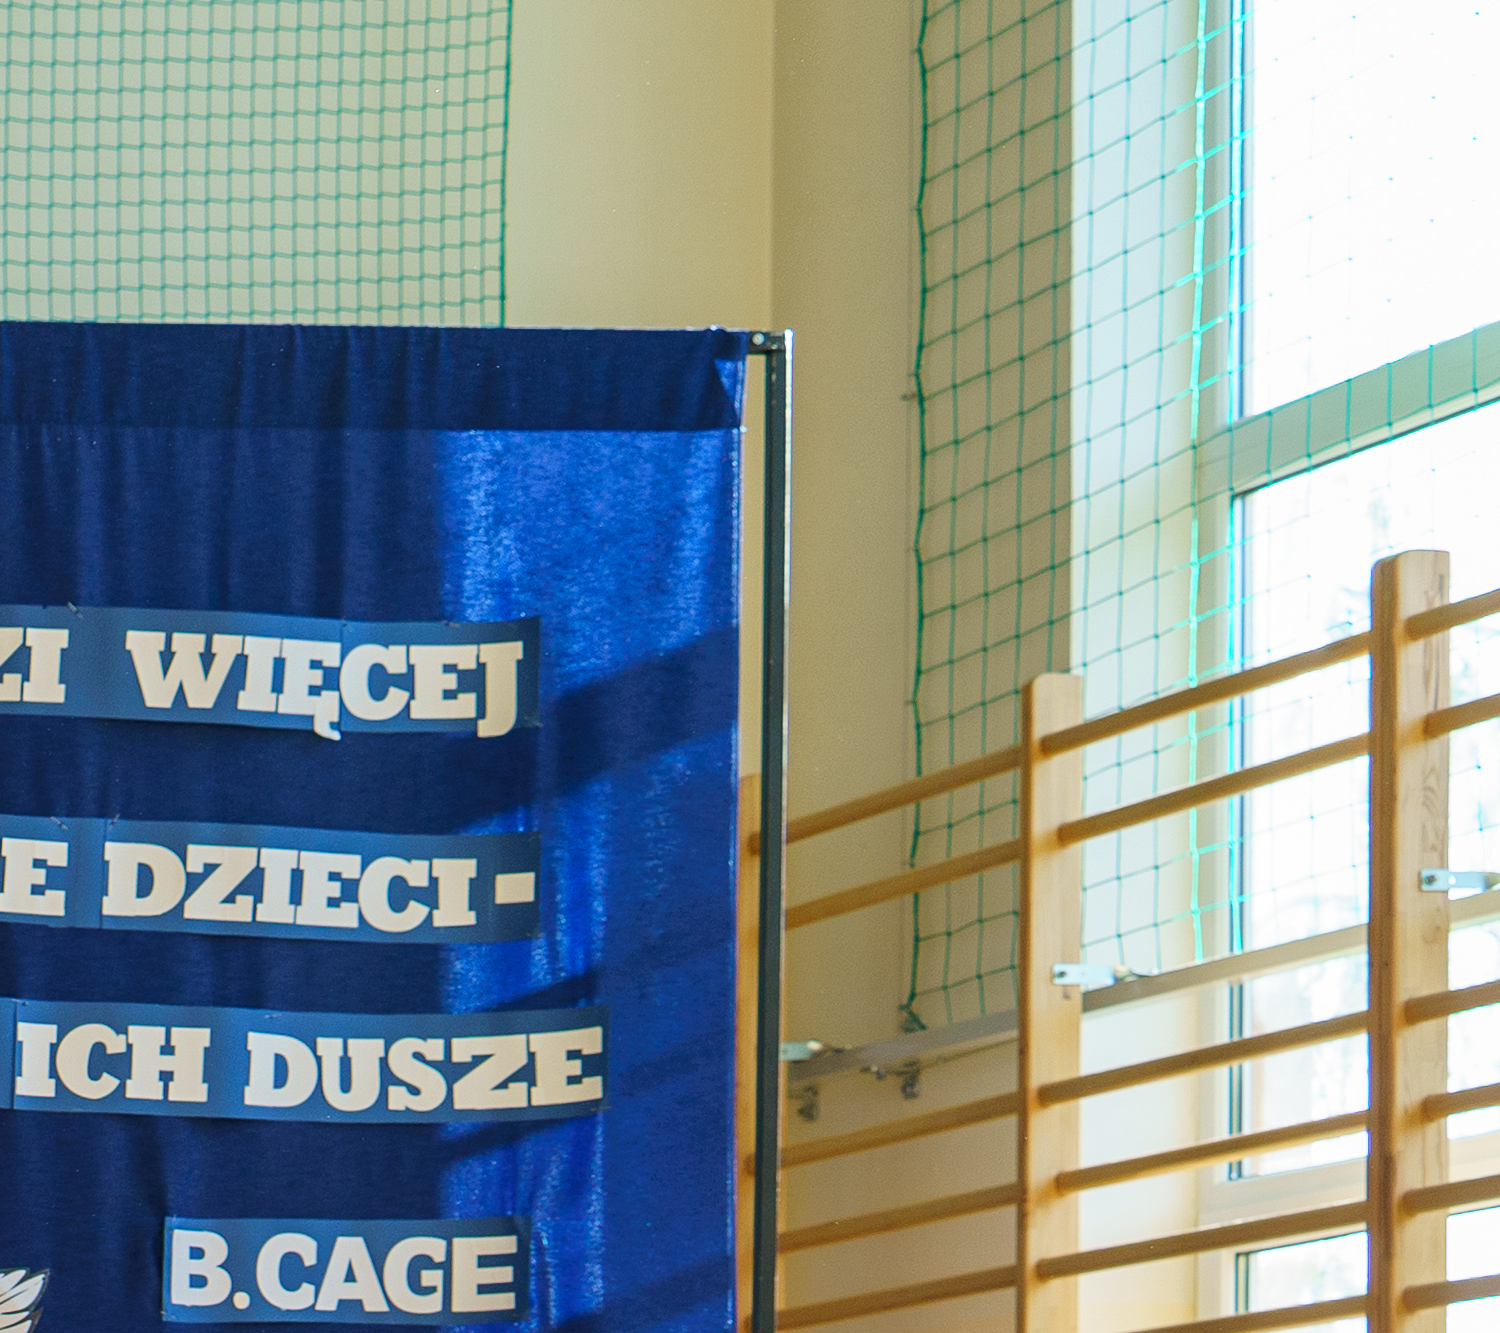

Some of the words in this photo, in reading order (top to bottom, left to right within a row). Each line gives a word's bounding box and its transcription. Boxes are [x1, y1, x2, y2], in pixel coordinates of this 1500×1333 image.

[125, 630, 524, 740] WIĘCEJ
[15, 1022, 212, 1104] ICH
[243, 1029, 604, 1114] DUSZE
